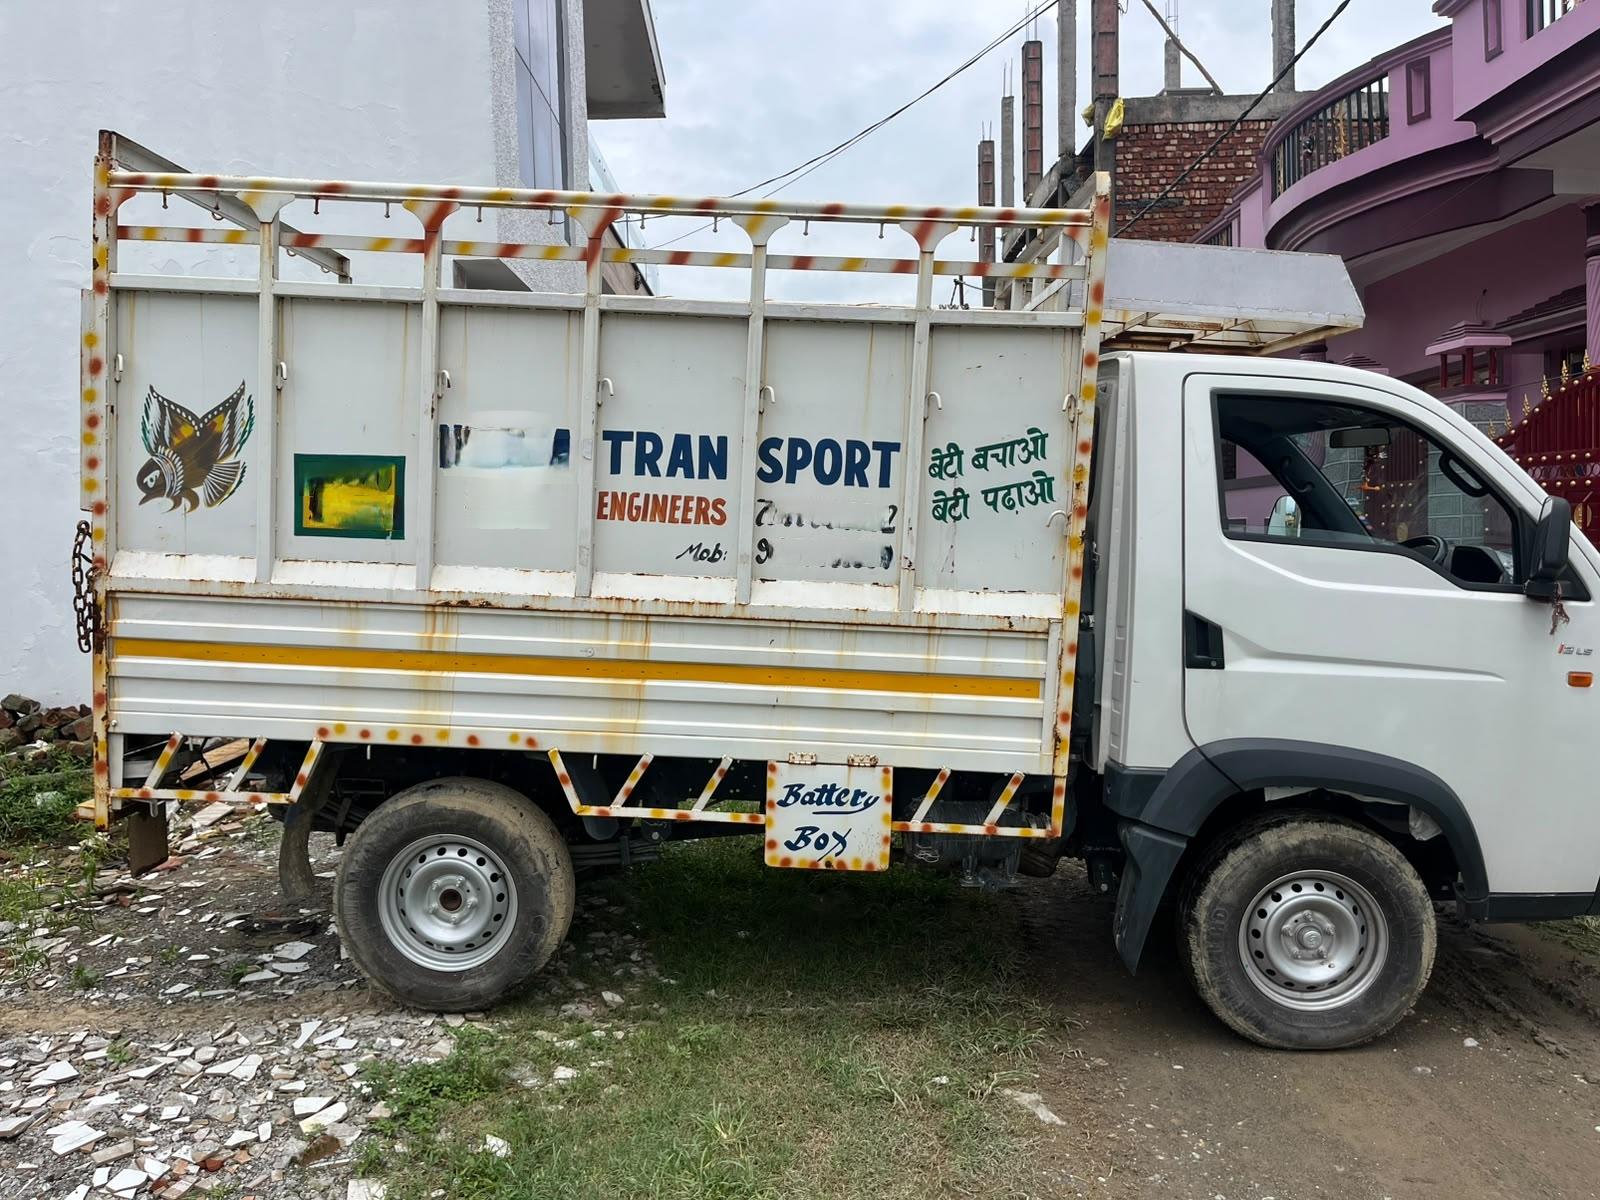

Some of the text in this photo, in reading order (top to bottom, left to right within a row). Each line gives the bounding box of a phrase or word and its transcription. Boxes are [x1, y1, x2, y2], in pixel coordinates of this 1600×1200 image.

[602, 430, 729, 480] TRAN
[757, 436, 902, 488] SPORT
[928, 427, 1049, 480] बेटी बचाओ
[596, 491, 728, 527] ENGINEERS
[931, 487, 970, 523] बेटी
[776, 783, 880, 815] Battery
[784, 825, 852, 862] Box
